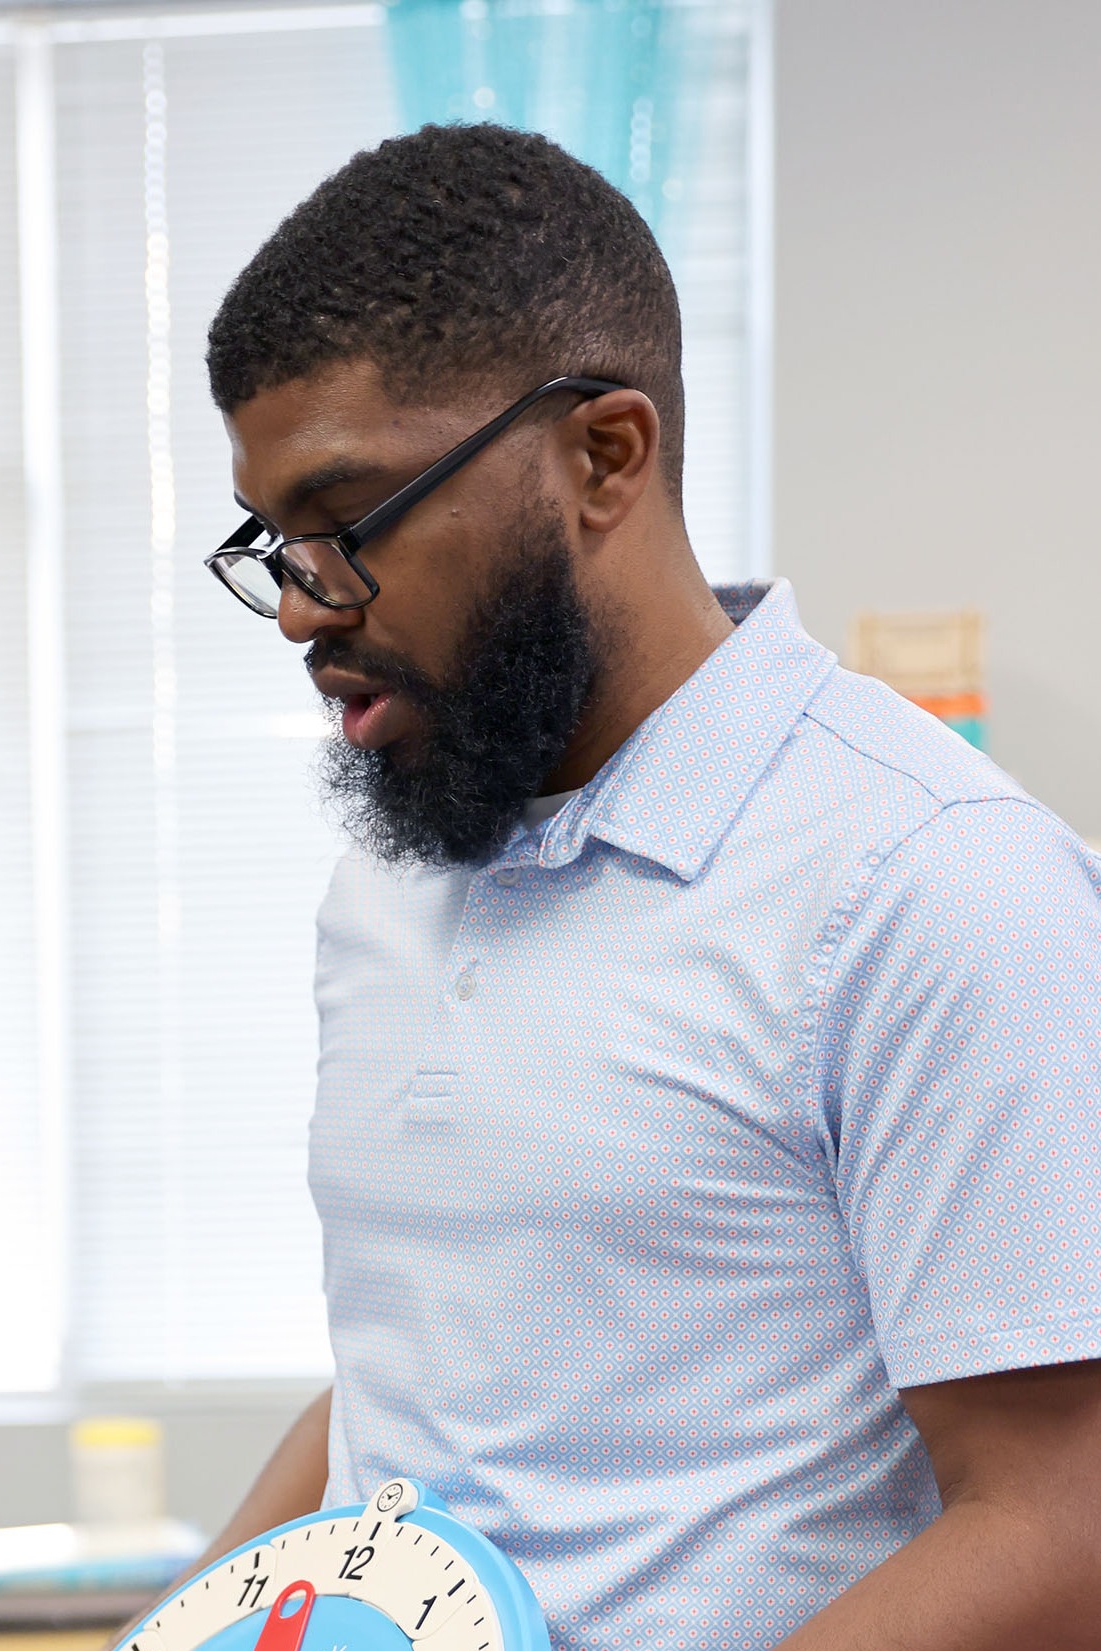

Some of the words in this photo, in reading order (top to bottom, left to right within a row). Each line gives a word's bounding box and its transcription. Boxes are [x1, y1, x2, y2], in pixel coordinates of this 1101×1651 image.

[338, 1545, 375, 1581] 12
[236, 1574, 269, 1608] 11
[415, 1596, 438, 1631] 1
